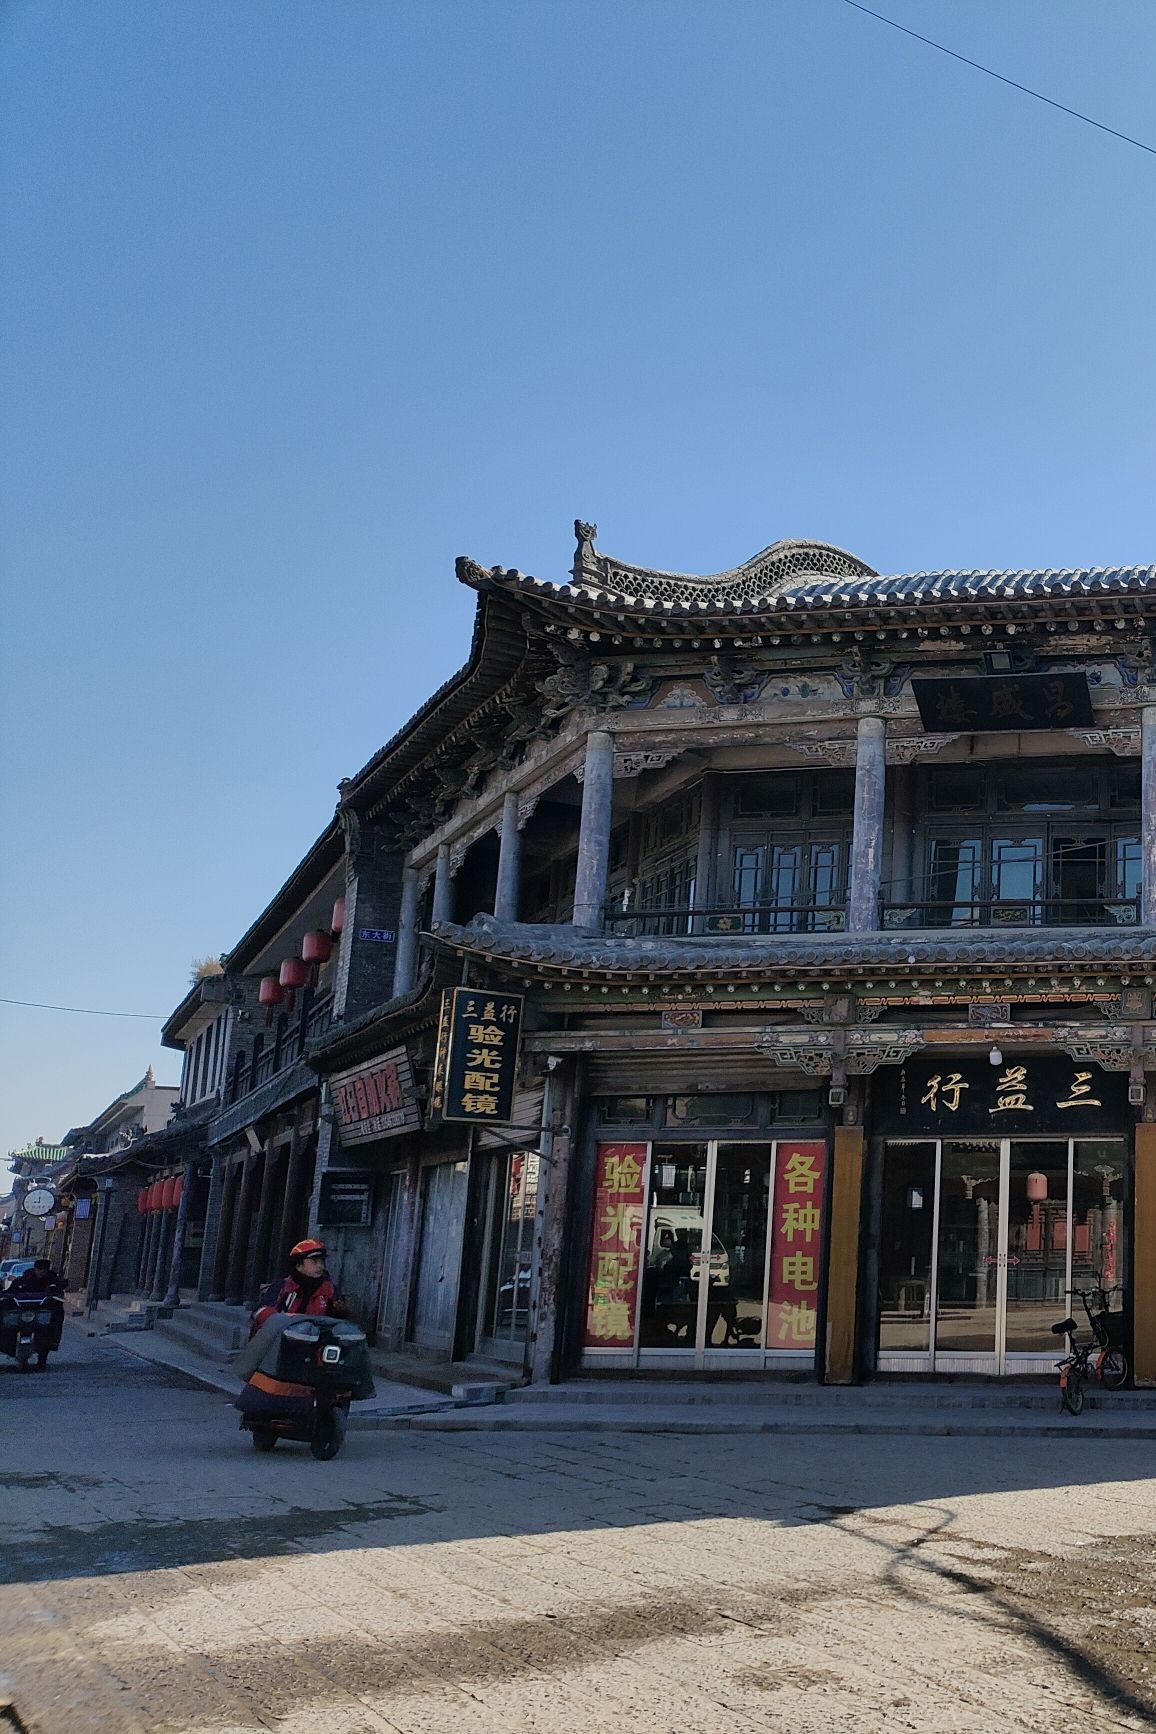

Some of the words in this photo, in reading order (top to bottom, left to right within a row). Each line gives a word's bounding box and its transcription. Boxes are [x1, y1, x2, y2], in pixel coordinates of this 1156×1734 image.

[361, 930, 392, 941] 东大街
[462, 1000, 517, 1023] 三益行
[460, 1024, 506, 1114] 验光配镜
[920, 1065, 1102, 1112] 三益行
[590, 1154, 642, 1341] 验光配镜
[778, 1153, 823, 1343] 各种电池
